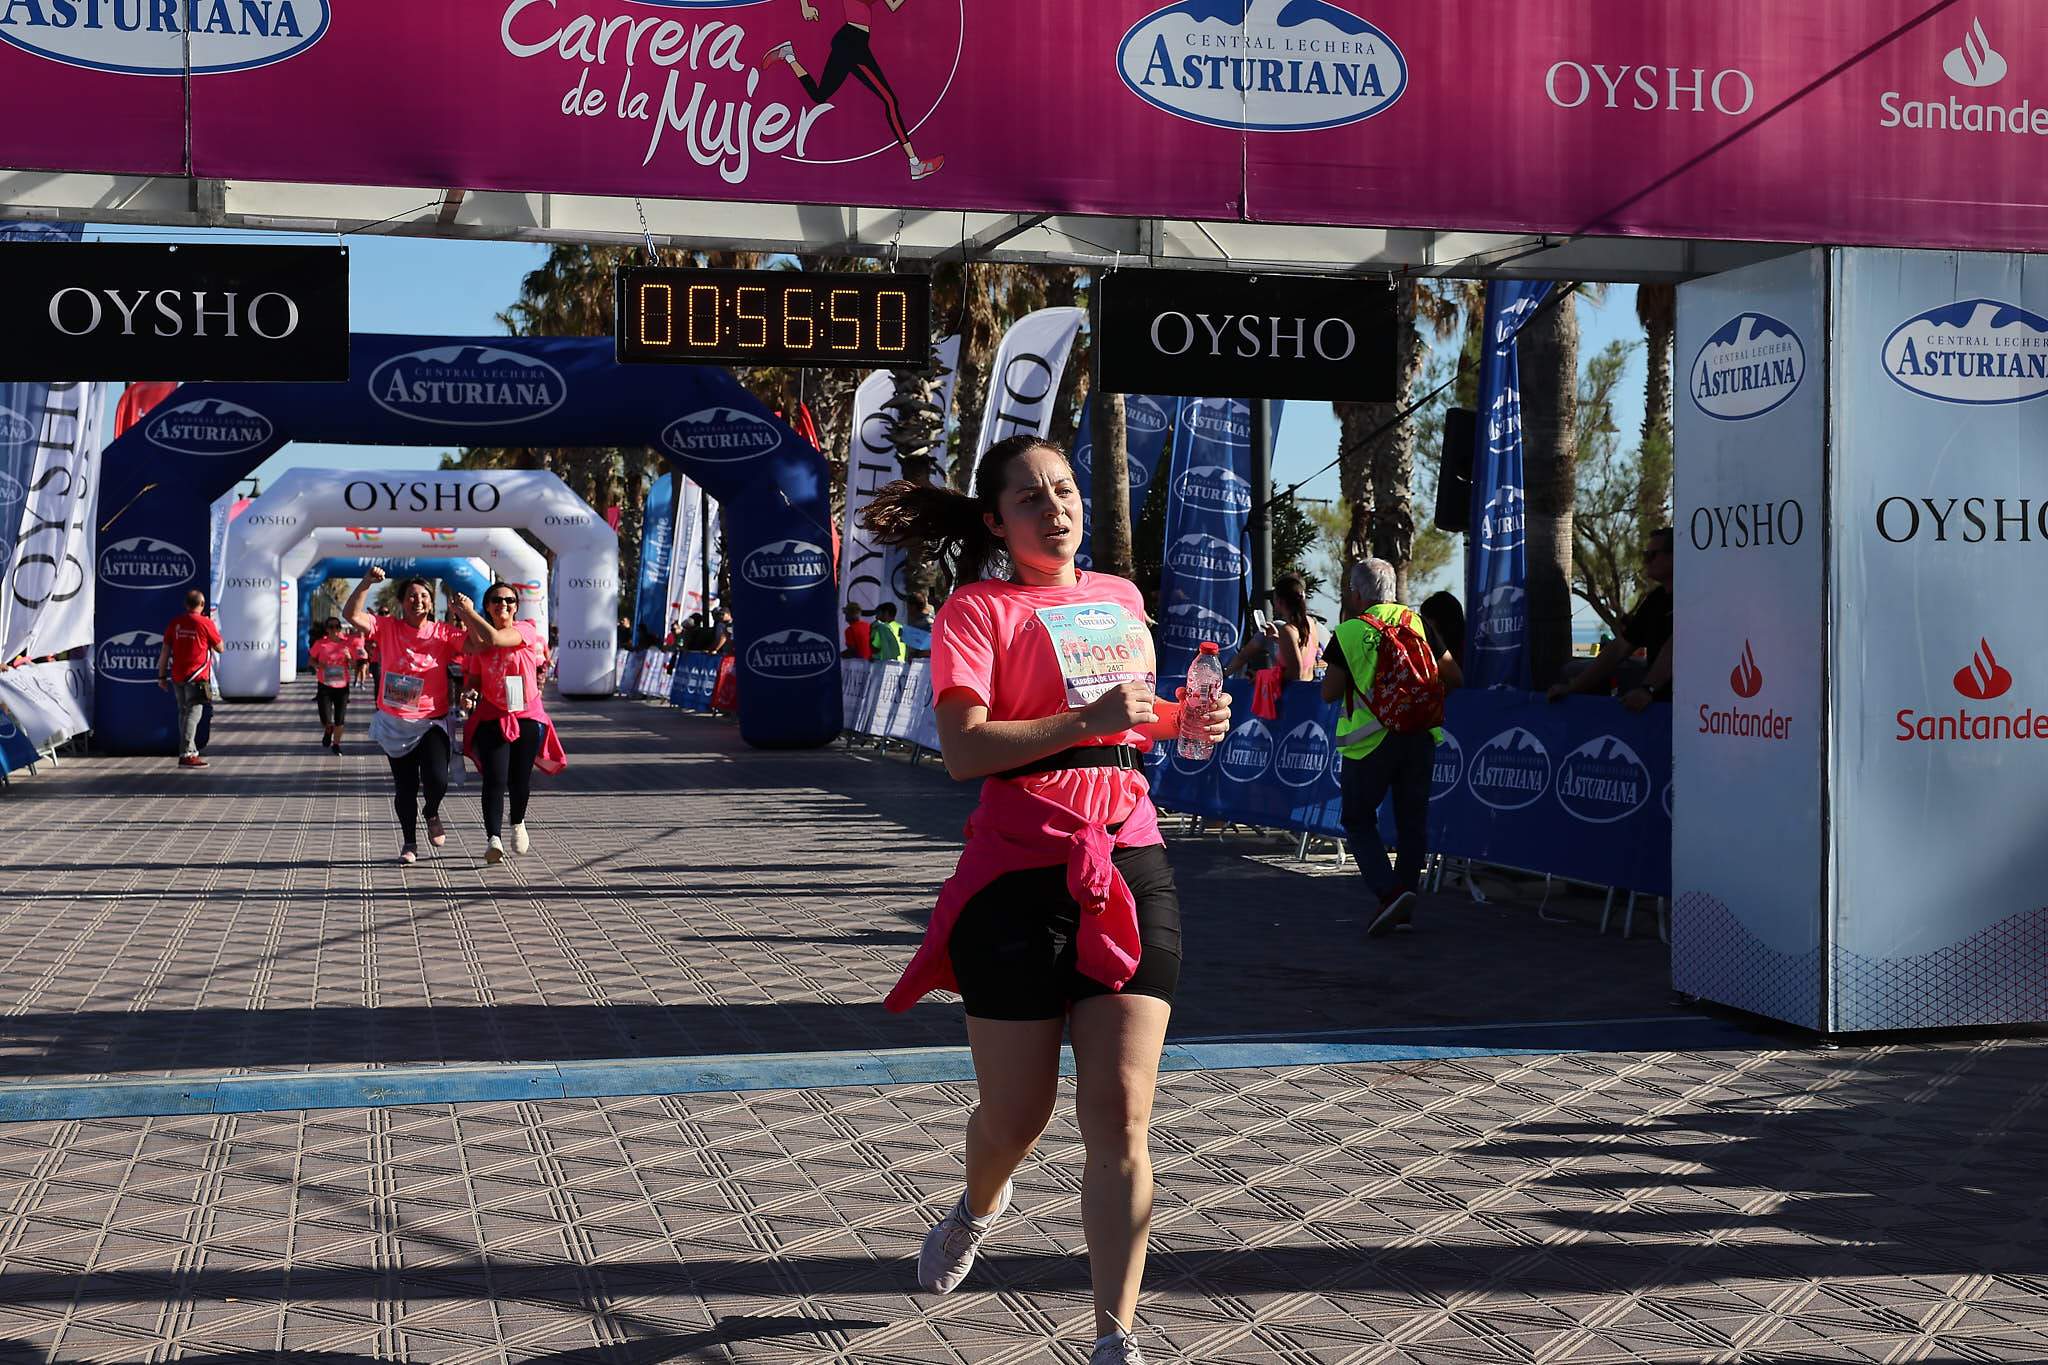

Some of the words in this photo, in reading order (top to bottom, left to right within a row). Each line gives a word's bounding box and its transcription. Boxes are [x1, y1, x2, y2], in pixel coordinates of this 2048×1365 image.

[501, 0, 745, 72] Carrera
[1186, 33, 1275, 50] CENTRAL
[1285, 39, 1376, 55] LECHERA
[1140, 34, 1386, 97] ASTURIANA
[1545, 60, 1755, 116] OYSHO
[561, 67, 607, 117] de
[617, 67, 649, 120] la
[642, 67, 835, 184] Mujer
[48, 287, 299, 339] OYSHO
[641, 284, 906, 351] 00:56:50
[1150, 311, 1356, 361] OYSHO
[1928, 335, 1989, 346] CENTRAL
[1713, 350, 1748, 366] CENTRAL
[1752, 342, 1792, 358] LECHERA
[1896, 336, 2048, 379] ASTURIAN
[384, 368, 552, 406] ASTURIANA
[1698, 357, 1796, 399] ASTURIANA
[153, 419, 263, 442] ASTURIANA
[1188, 407, 1250, 438] ASTURIA
[672, 429, 774, 449] ASTURIANA
[12, 381, 79, 609] OYSH
[344, 481, 500, 512] OYSHO
[248, 515, 297, 526] OYSHO
[545, 515, 591, 526] OYSHO
[1691, 499, 1803, 551] OYSHO
[1875, 497, 2048, 543] OYSH
[102, 557, 189, 577] ASTURIANA
[748, 560, 827, 578] ASTURIANA
[227, 577, 272, 589] OYSHO
[568, 578, 612, 589] OYSHO
[225, 640, 271, 651] OYSHO
[567, 639, 611, 650] OYSHO
[752, 649, 832, 668] ASTURIANA
[1699, 703, 1792, 740] Santander
[1223, 741, 1268, 767] ASTURIANA
[1278, 744, 1324, 771] ASTURIANA
[1472, 755, 1543, 791] ASTURIANA
[1561, 764, 1638, 805] ASTURIANA
